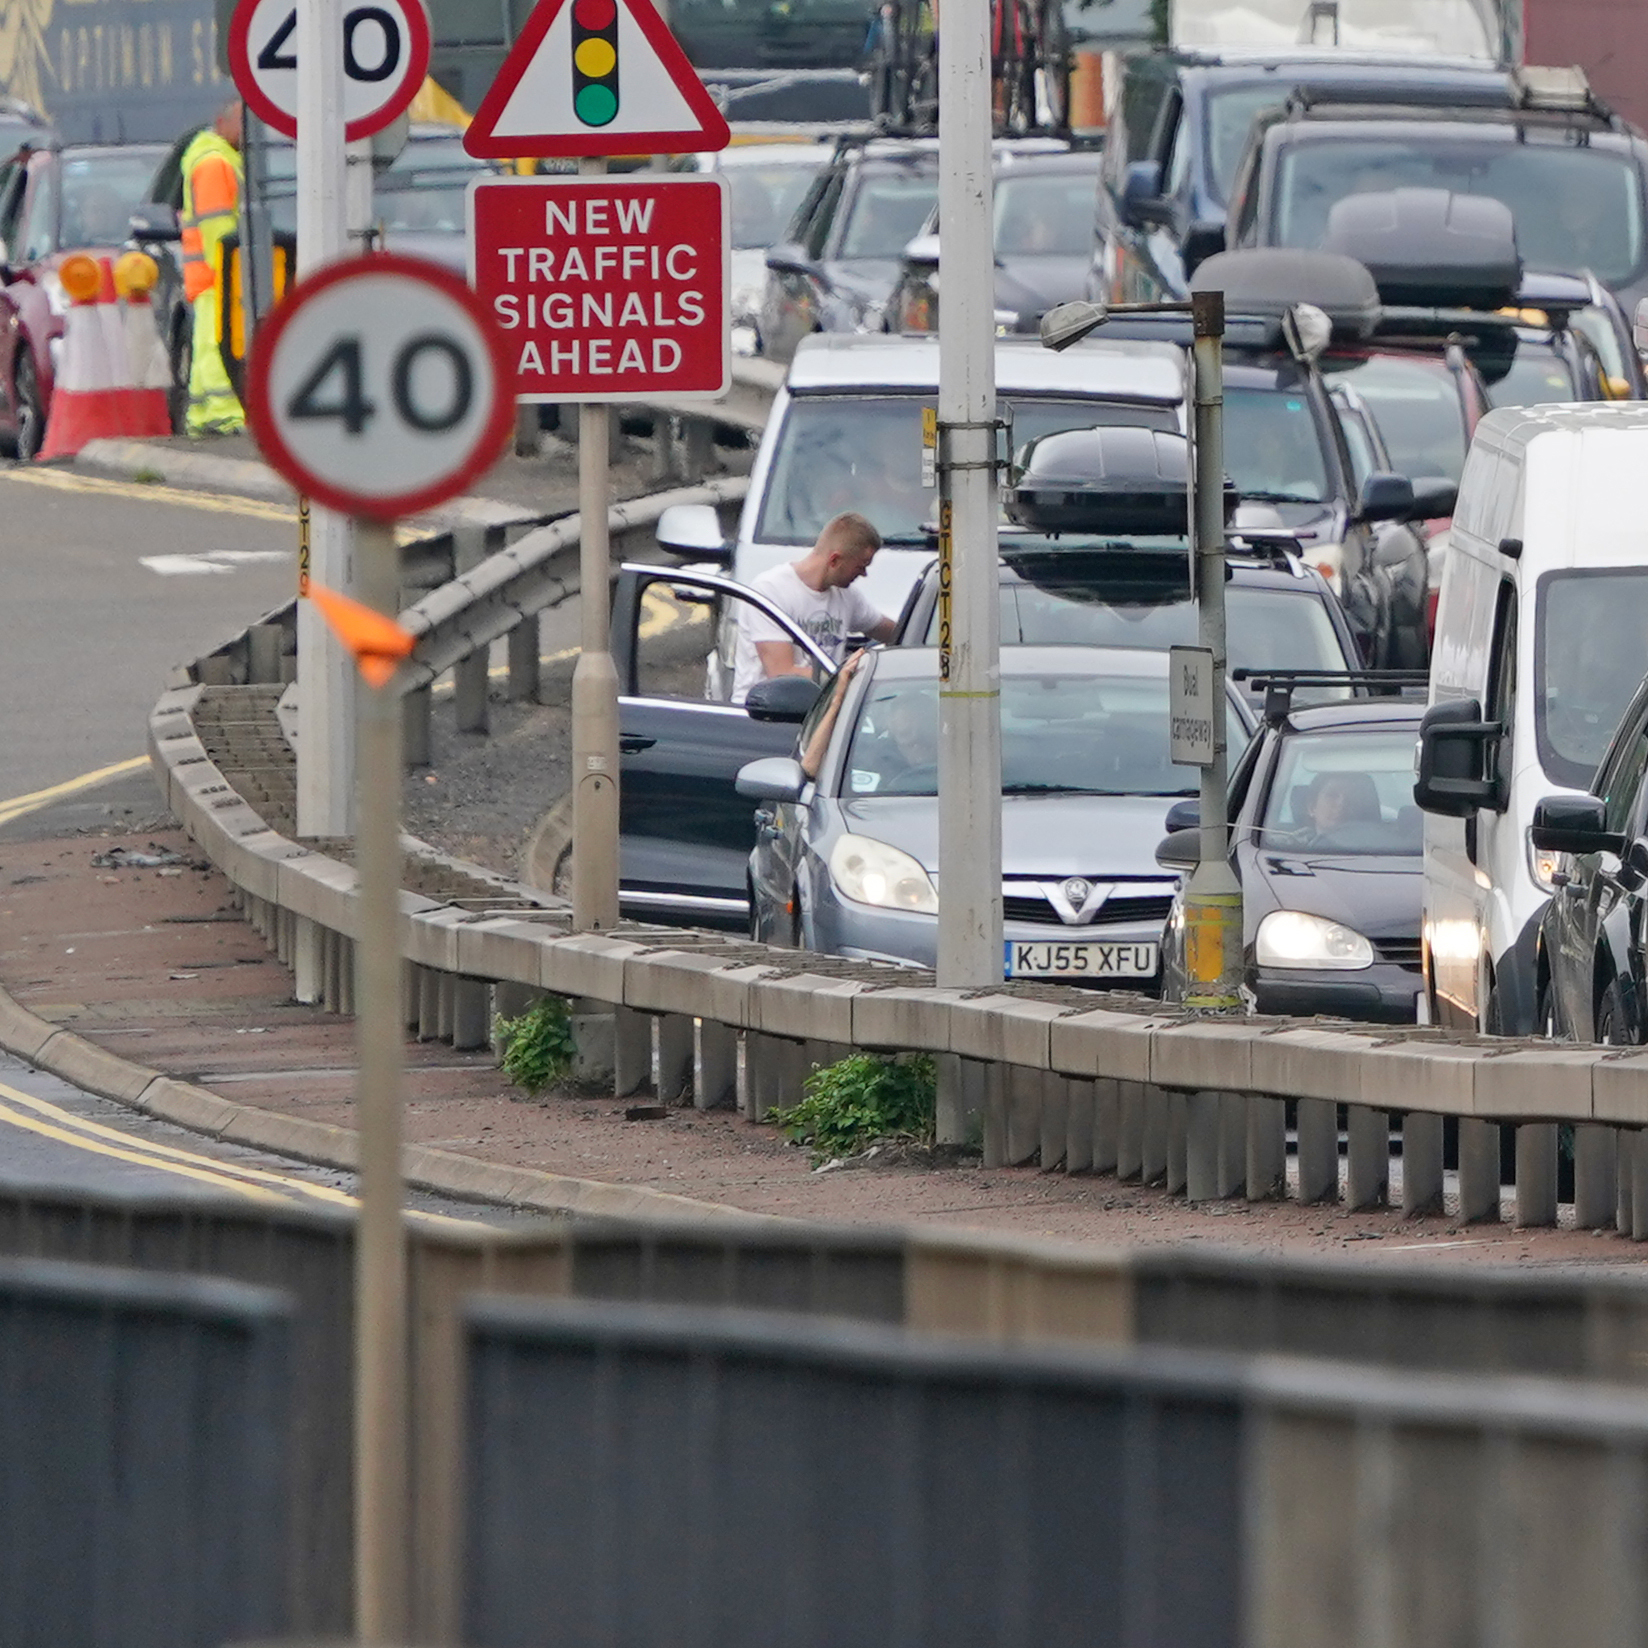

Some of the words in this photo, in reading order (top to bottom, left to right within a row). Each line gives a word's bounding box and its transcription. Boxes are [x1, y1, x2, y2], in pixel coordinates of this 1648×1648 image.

[545, 198, 655, 236] NEW
[497, 243, 699, 283] TRAFFIC
[493, 290, 706, 330] SIGNALS
[516, 338, 683, 376] AHEAD
[286, 330, 475, 436] 40
[939, 504, 952, 680] GTCT28
[1183, 664, 1199, 697] Dual
[1017, 945, 1088, 971] KJ55
[1099, 945, 1151, 971] XFU
